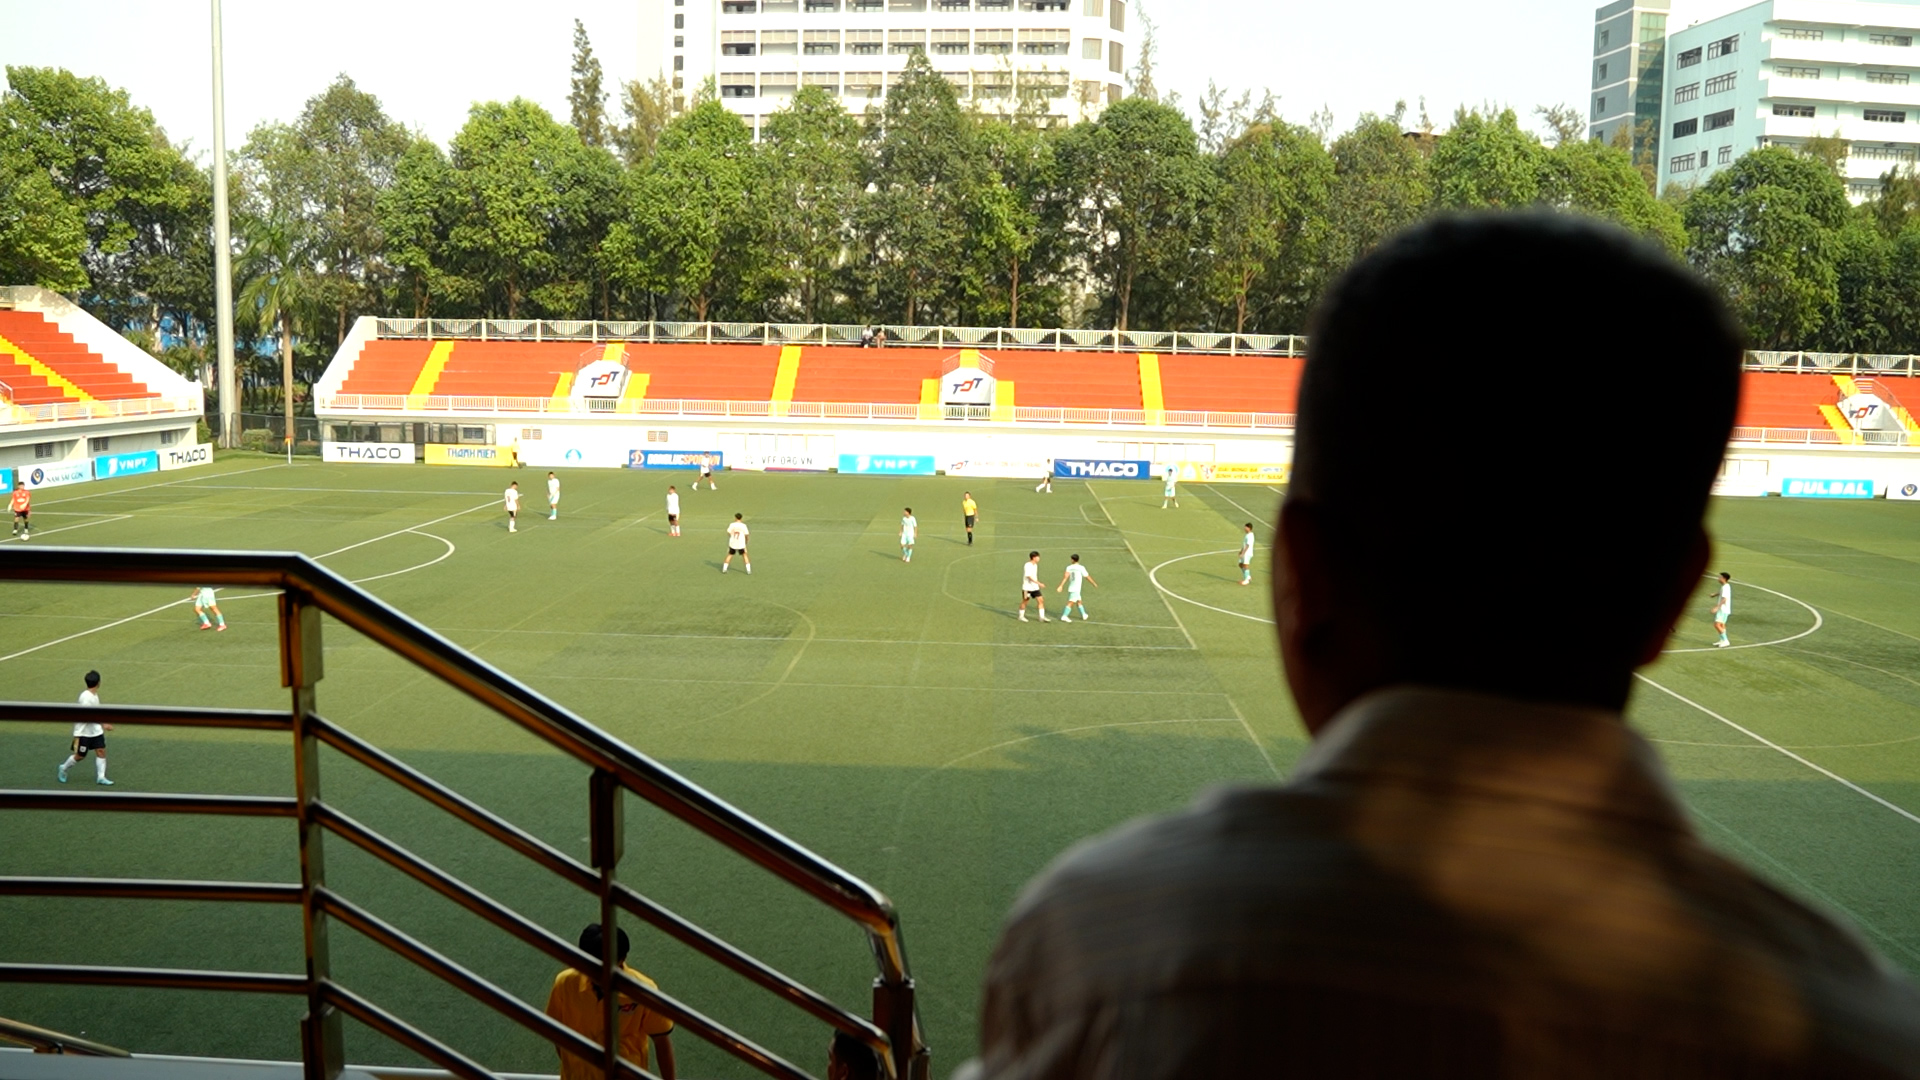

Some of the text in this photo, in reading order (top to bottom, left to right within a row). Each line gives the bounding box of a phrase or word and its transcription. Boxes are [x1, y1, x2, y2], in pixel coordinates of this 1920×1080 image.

[169, 448, 207, 465] THACO
[336, 446, 401, 459] THACO
[118, 457, 148, 470] VNPT
[873, 459, 918, 469] VNPT
[1067, 461, 1139, 477] THACO
